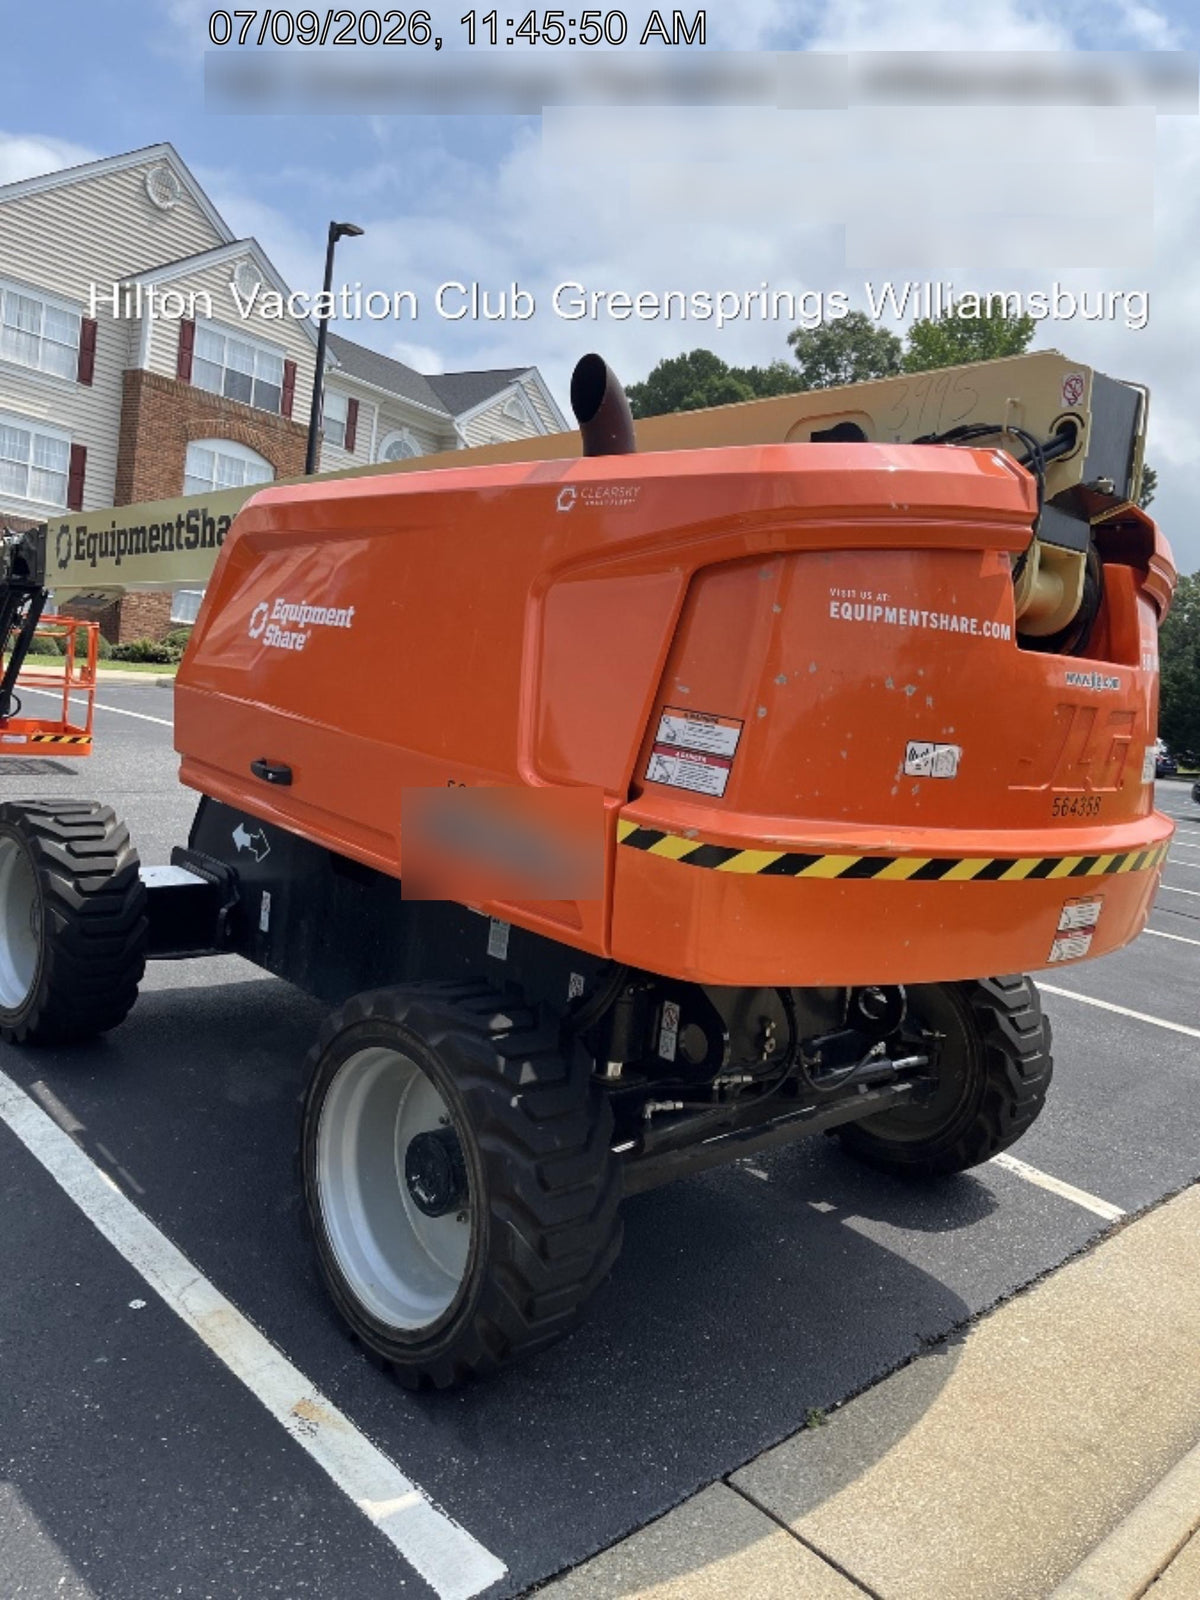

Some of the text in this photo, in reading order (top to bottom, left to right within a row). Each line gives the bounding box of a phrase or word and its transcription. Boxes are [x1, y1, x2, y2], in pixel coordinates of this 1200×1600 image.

[74, 507, 238, 568] EquipmentSha
[860, 590, 873, 600] US
[270, 598, 355, 629] Equipment
[829, 600, 1012, 642] EQUIPMENTSHARE.COM
